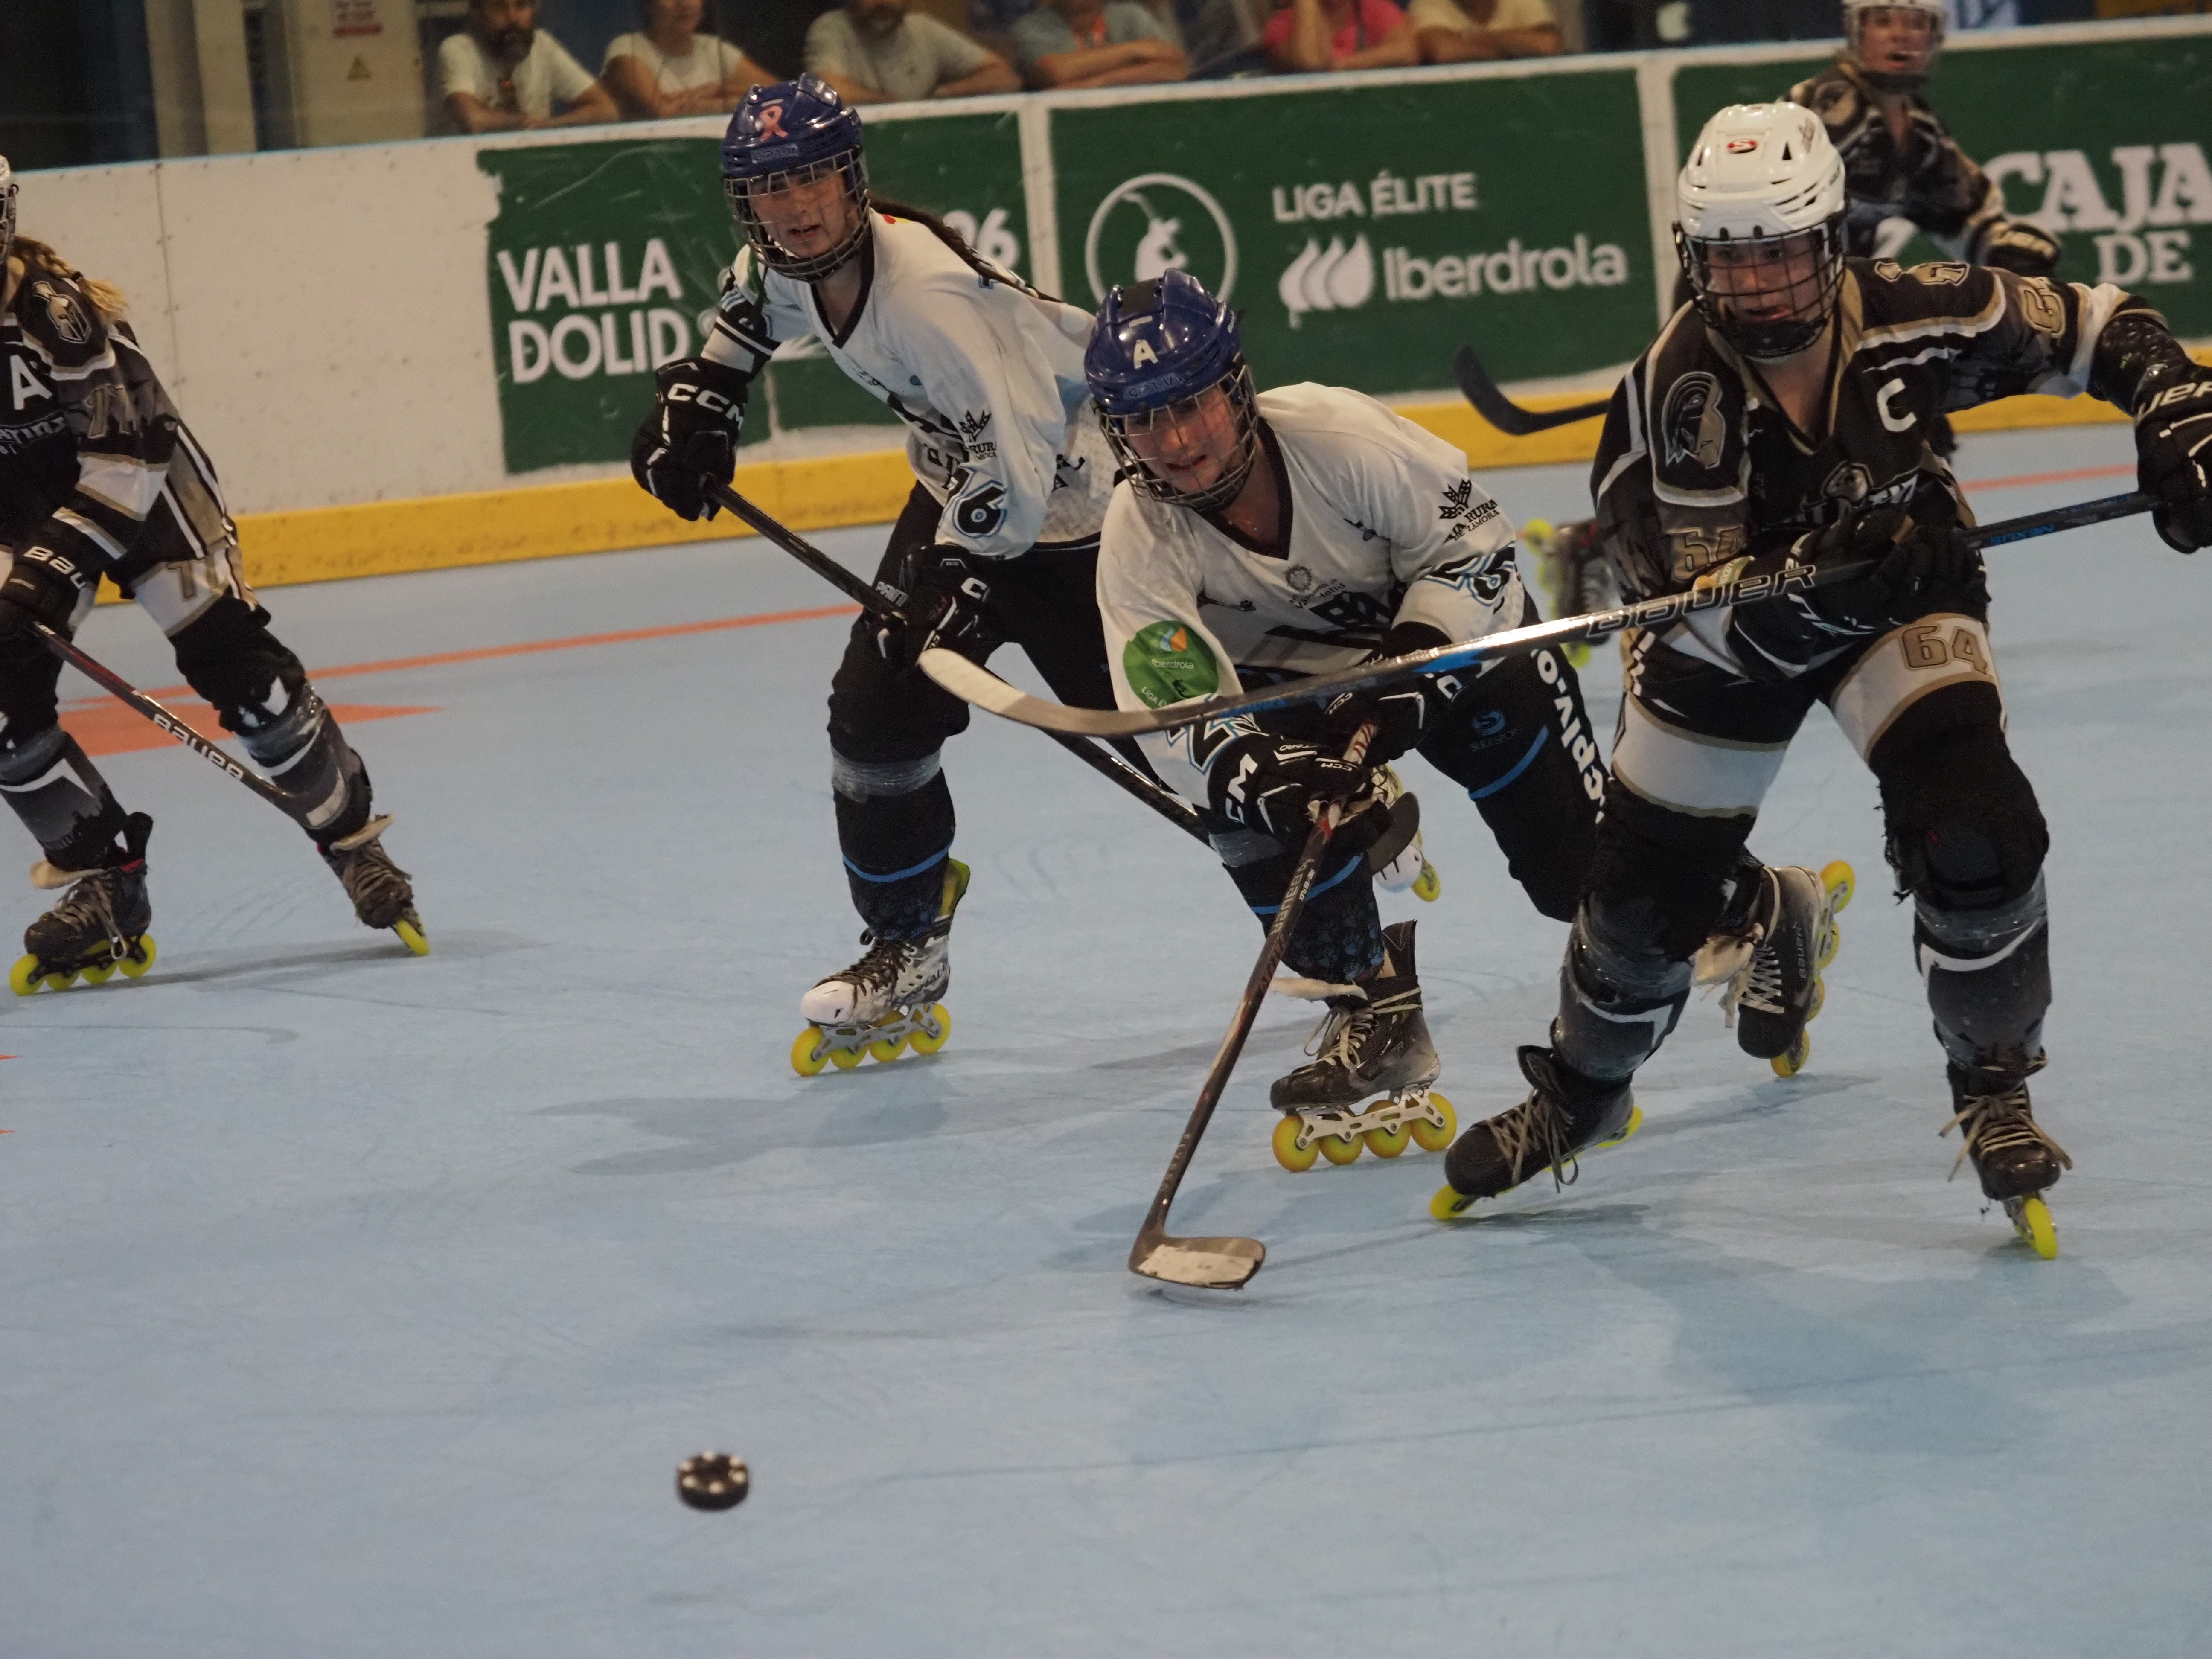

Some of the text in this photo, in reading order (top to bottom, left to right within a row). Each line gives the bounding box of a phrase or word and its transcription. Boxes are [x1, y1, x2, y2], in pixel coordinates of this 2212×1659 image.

[1272, 170, 1478, 222] LIGA ÉLITE
[1981, 142, 2212, 233] CAJA
[496, 237, 683, 312] VALLA
[1383, 232, 1628, 302] Iberdrola
[2092, 229, 2194, 285] DE
[509, 308, 692, 384] DOLID
[1133, 339, 1159, 370] A
[10, 355, 53, 410] A
[667, 383, 745, 431] CCM
[1877, 378, 1917, 433] C
[1901, 625, 1988, 676] 64
